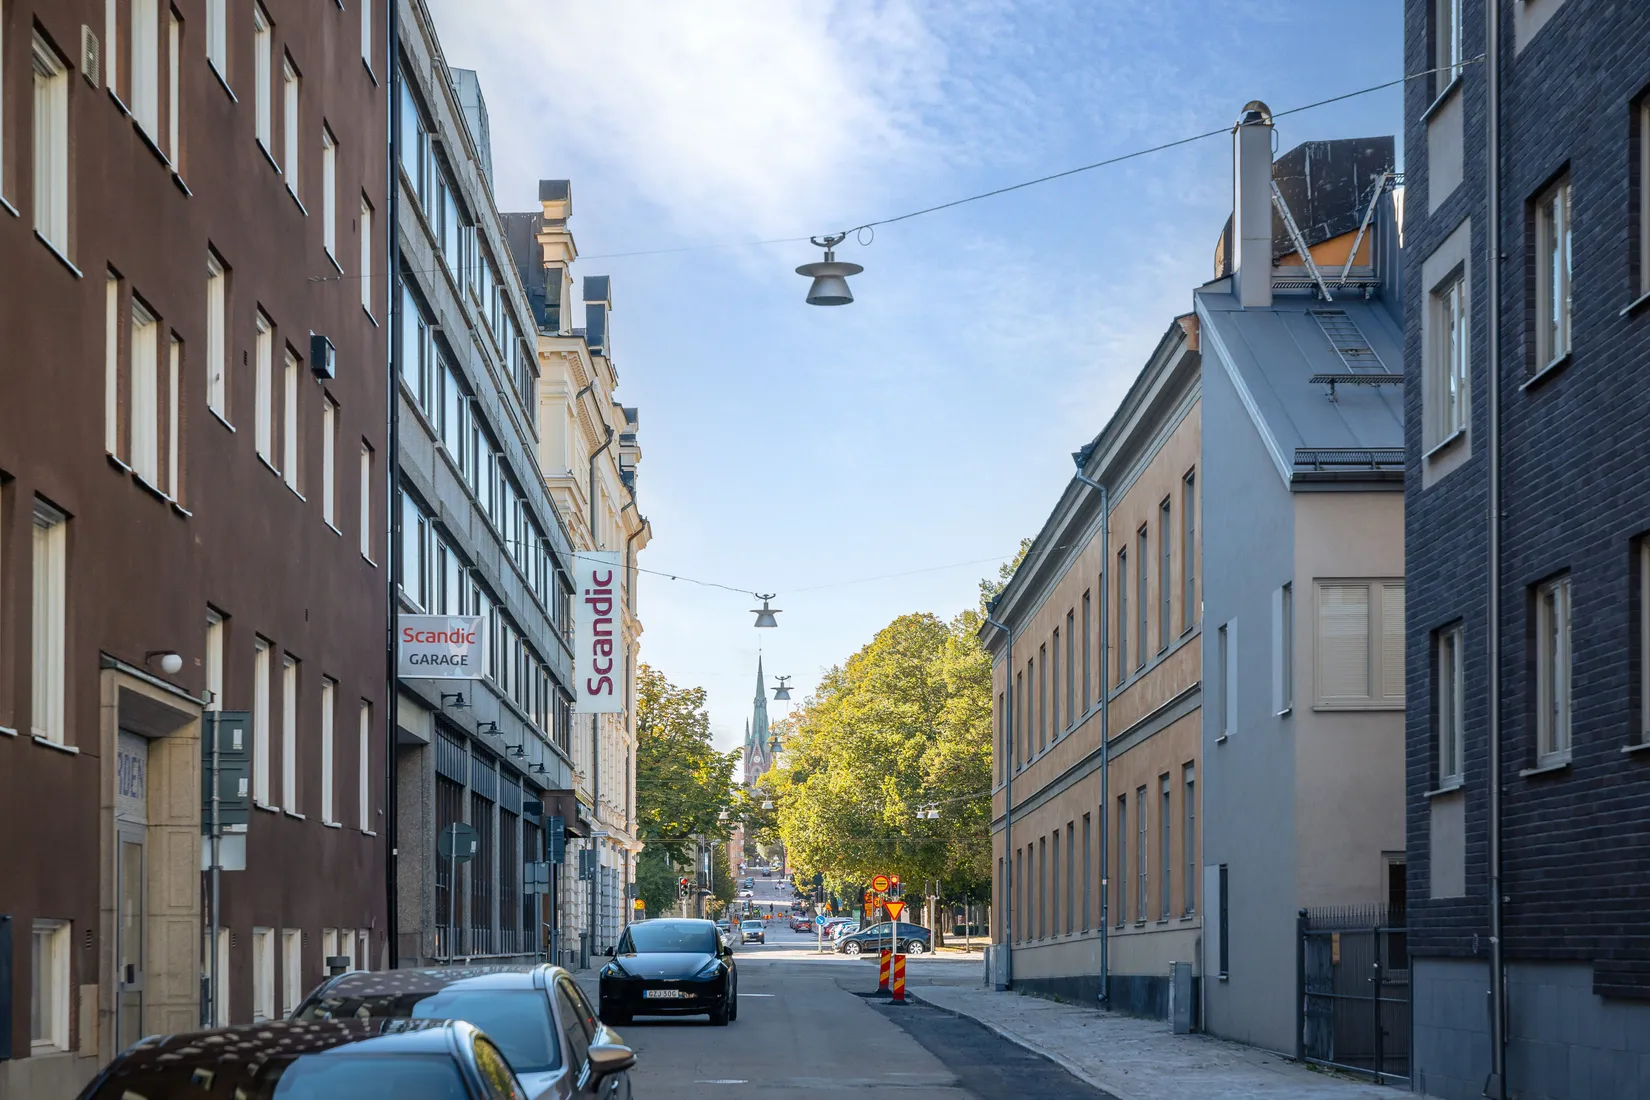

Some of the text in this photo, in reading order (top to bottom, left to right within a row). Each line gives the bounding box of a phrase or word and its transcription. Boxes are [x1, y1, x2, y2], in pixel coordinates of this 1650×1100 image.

[403, 627, 476, 645] Scandic
[585, 570, 613, 696] Scandic
[409, 653, 469, 666] GARAGE
